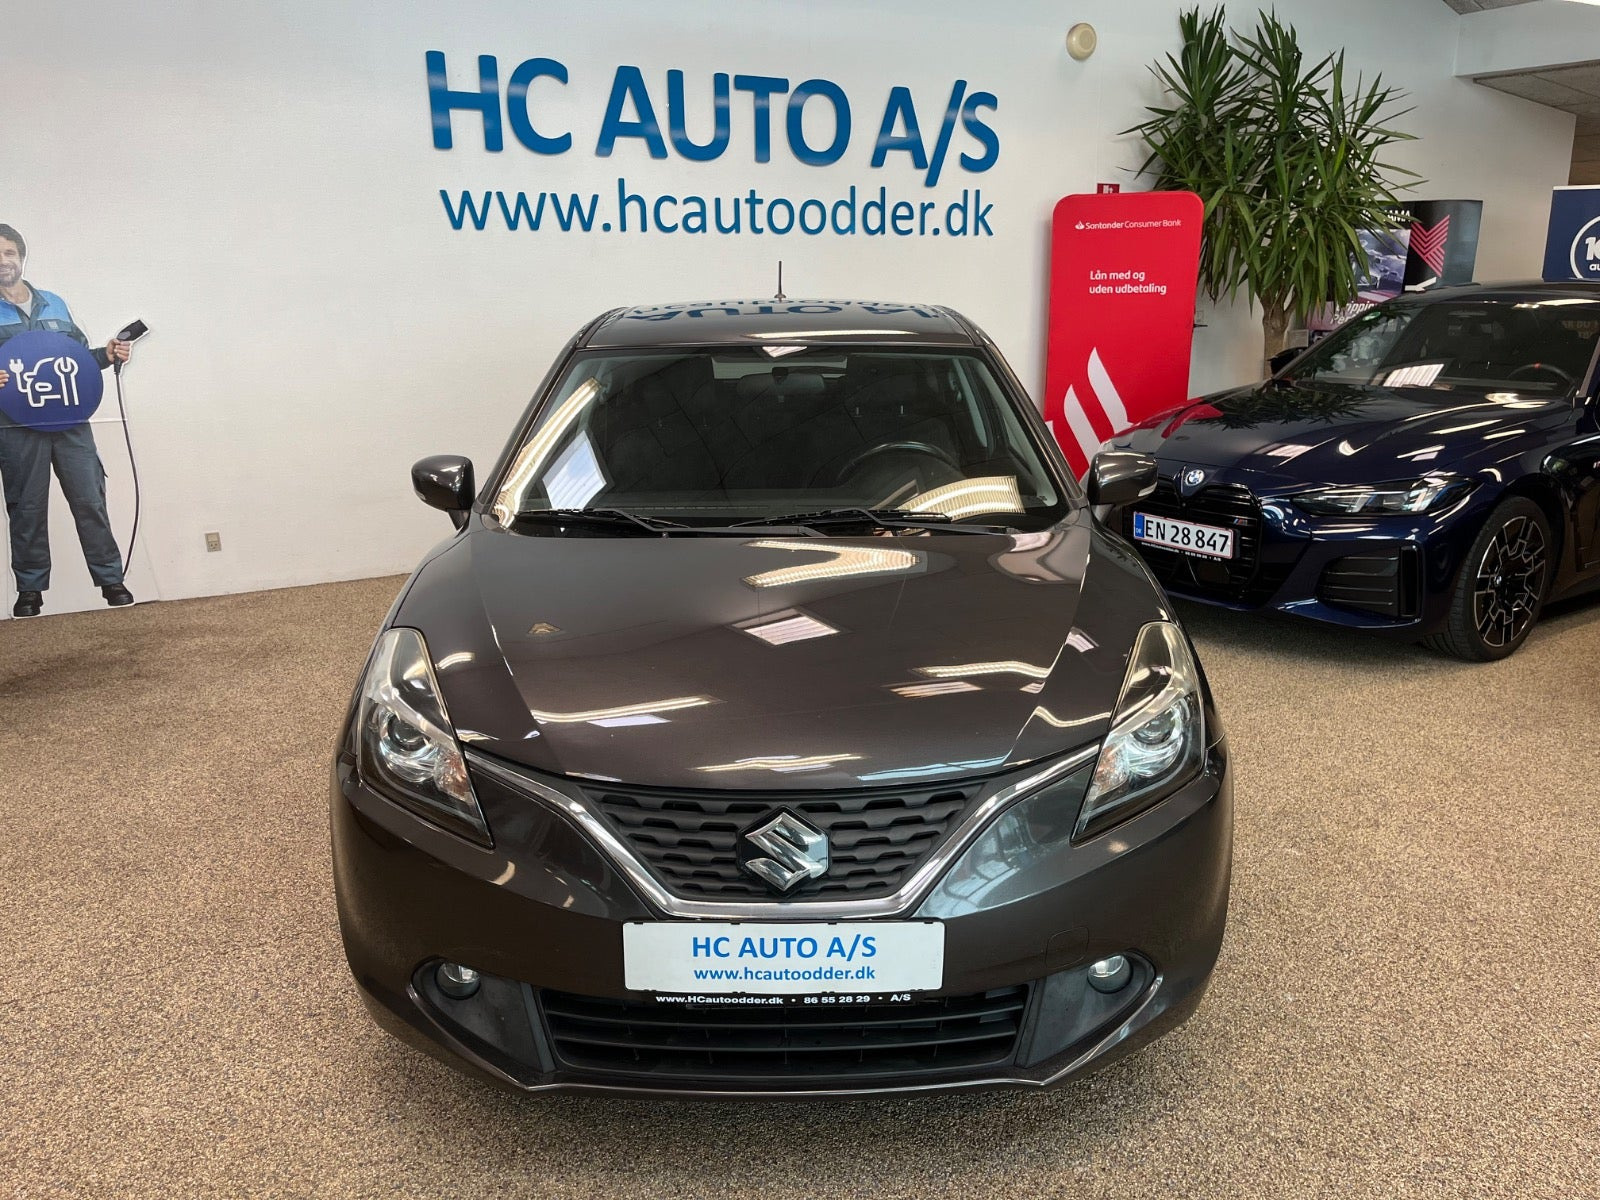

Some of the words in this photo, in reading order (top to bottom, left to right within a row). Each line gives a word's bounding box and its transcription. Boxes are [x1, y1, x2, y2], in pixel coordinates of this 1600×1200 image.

[425, 50, 573, 155] HC
[595, 65, 852, 167] AUTO
[870, 79, 1000, 188] A/S
[439, 177, 995, 237] www.hcautoodder.dk
[1085, 221, 1124, 230] Santander
[1124, 220, 1163, 229] Consumer
[1162, 219, 1182, 227] Bank
[1090, 270, 1107, 281] Lån
[1109, 270, 1131, 280] med
[1132, 272, 1146, 282] og
[1089, 284, 1113, 294] uden
[1115, 283, 1167, 295] udbetaling
[1145, 519, 1166, 541] EN
[1170, 525, 1191, 546] 28
[1195, 529, 1229, 553] 847
[692, 936, 730, 958] HC
[738, 936, 818, 959] AUTO
[827, 934, 877, 962] A/S
[694, 966, 876, 981] www.hcautoodder.dk
[655, 994, 784, 1005] www.HCautoodder.dk
[803, 995, 819, 1005] 86
[821, 995, 836, 1005] 55
[838, 995, 853, 1004] 28
[856, 994, 871, 1004] 29
[890, 993, 912, 1003] A/S
